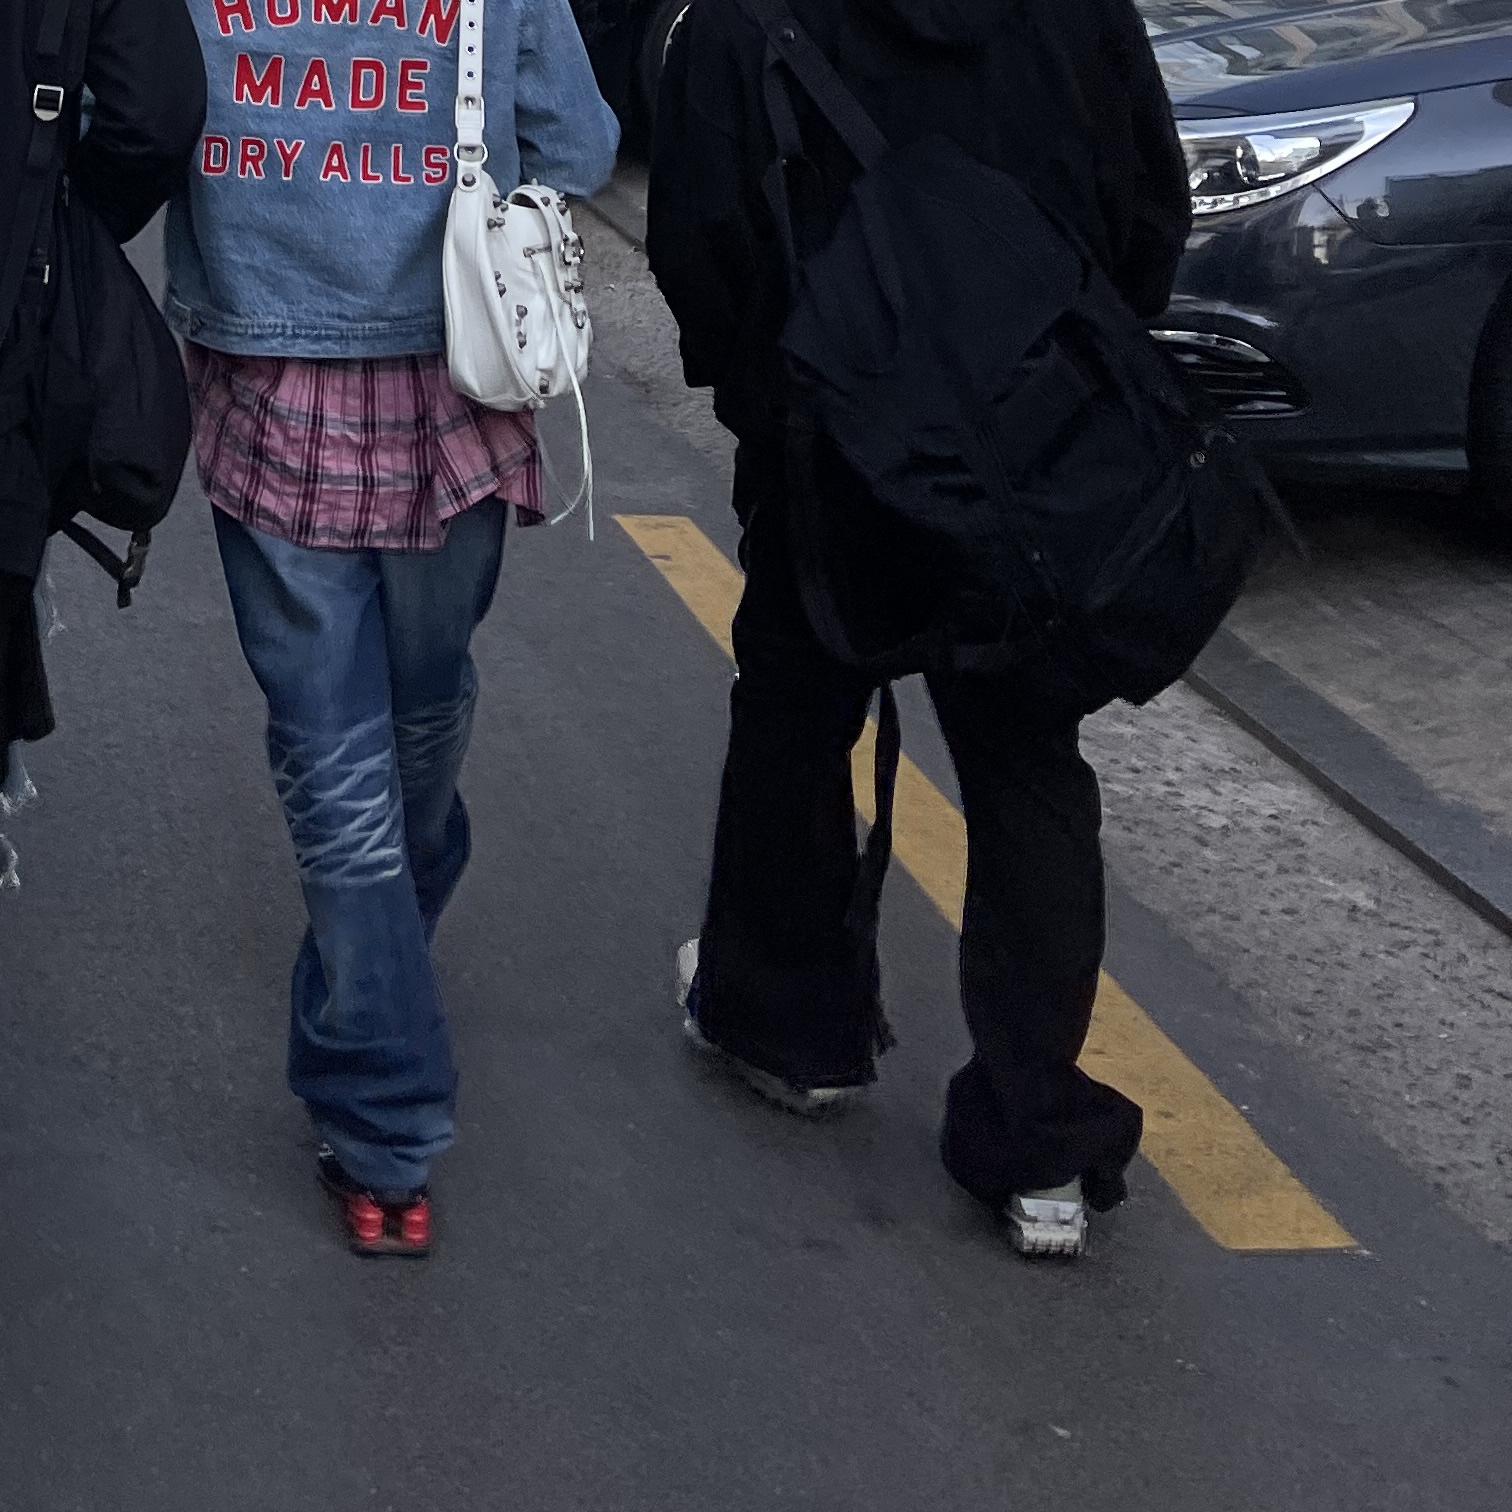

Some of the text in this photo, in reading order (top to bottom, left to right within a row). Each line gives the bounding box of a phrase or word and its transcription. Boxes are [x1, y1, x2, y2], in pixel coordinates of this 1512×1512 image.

[233, 52, 431, 113] MADE
[201, 136, 451, 185] DRY ALLS
